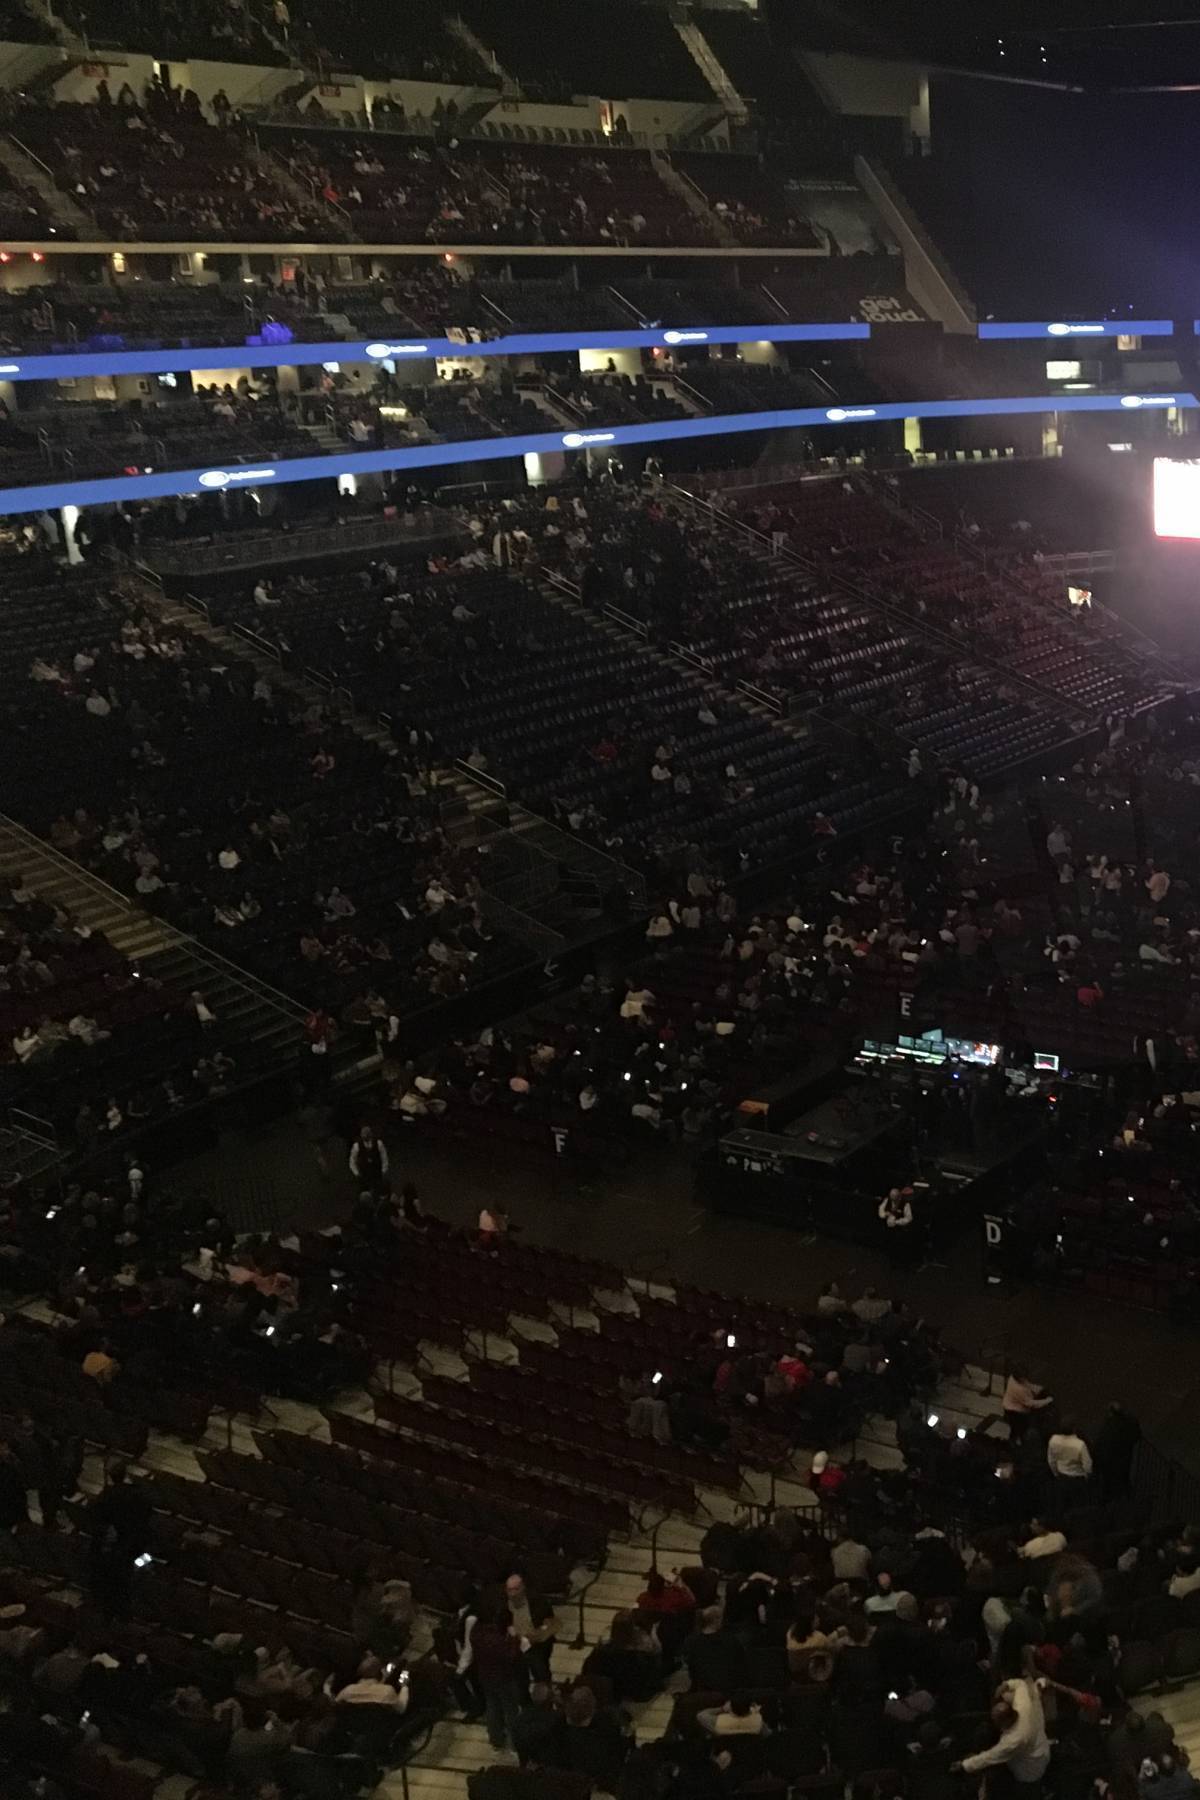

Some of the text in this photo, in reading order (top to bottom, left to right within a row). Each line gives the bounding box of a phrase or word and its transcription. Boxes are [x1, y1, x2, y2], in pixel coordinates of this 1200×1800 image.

[901, 997, 911, 1017] E
[555, 1133, 566, 1153] F
[986, 1221, 1001, 1244] D
